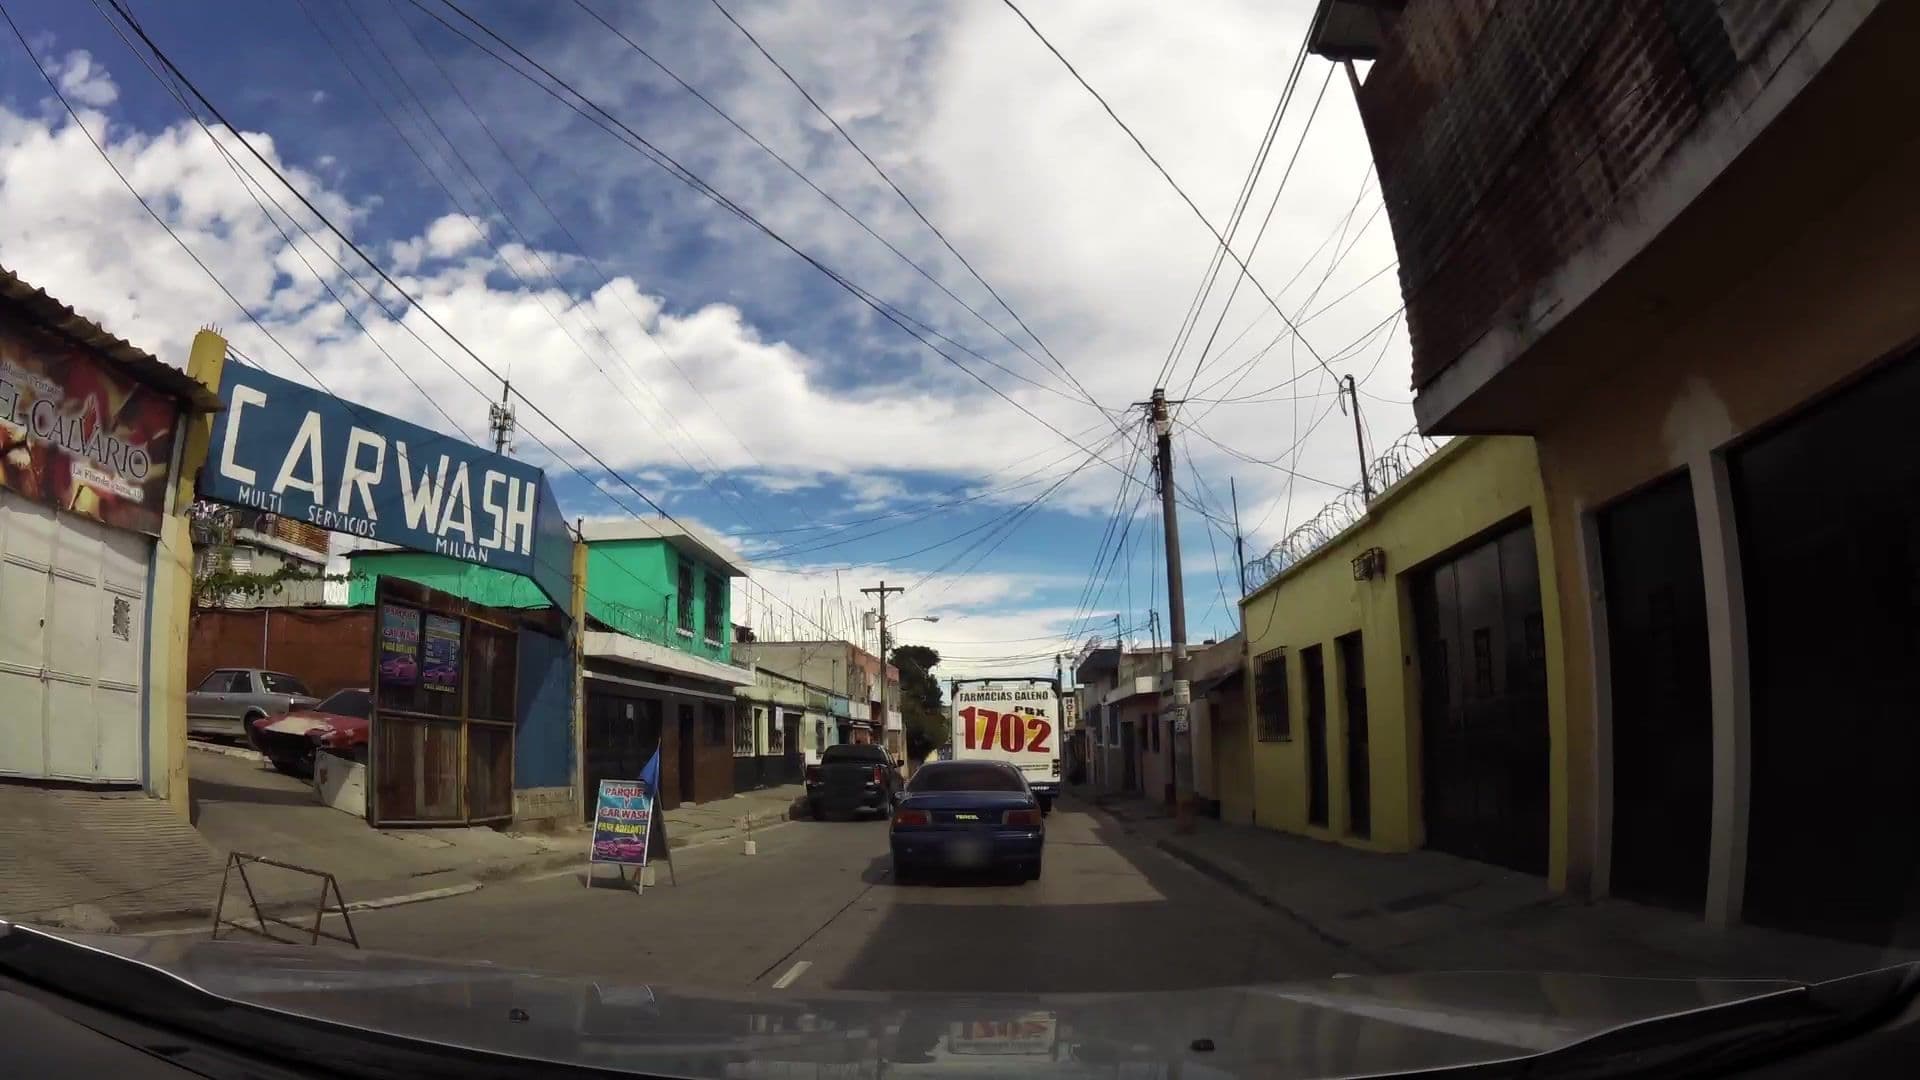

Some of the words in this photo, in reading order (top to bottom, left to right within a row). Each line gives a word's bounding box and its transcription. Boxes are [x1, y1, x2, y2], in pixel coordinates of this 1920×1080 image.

[0, 378, 26, 426] EL
[32, 400, 149, 479] CALVARIO
[238, 484, 283, 514] MULTI
[307, 504, 377, 538] SERVICIOS
[435, 537, 489, 563] MILIAN
[960, 691, 1013, 702] FARMACIAS
[1014, 690, 1049, 701] GALENO
[958, 706, 1052, 752] 1702
[599, 807, 620, 818] CAR
[620, 809, 650, 820] WASH
